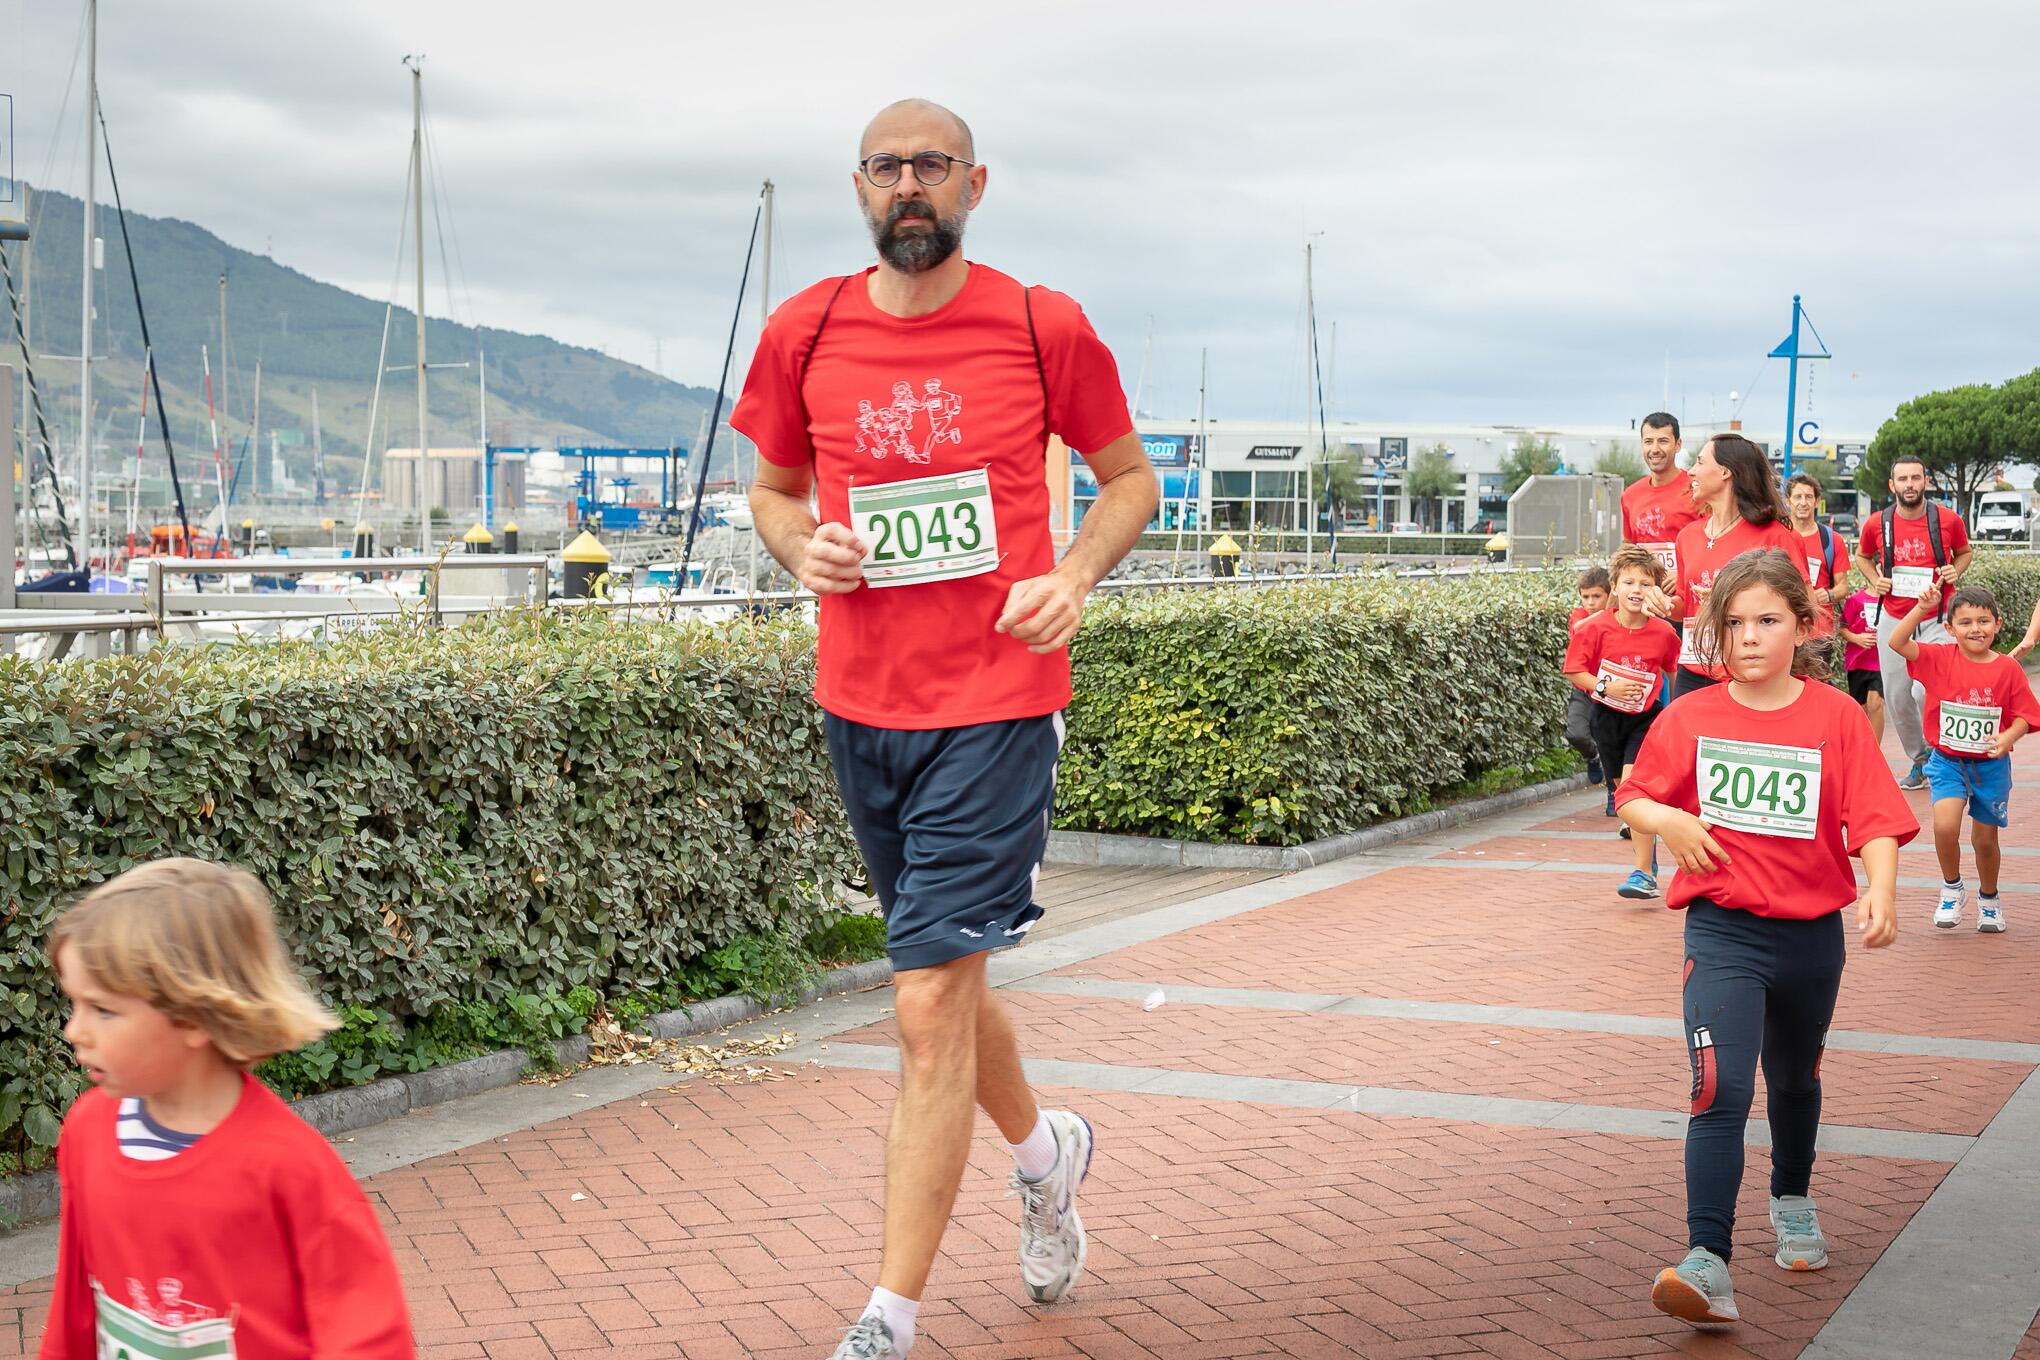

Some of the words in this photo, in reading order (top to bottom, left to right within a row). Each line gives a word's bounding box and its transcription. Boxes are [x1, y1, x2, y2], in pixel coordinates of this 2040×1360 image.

[1798, 421, 1819, 445] C
[869, 502, 981, 561] 2043
[1944, 716, 1994, 741] 2039
[1709, 763, 1807, 815] 2043
